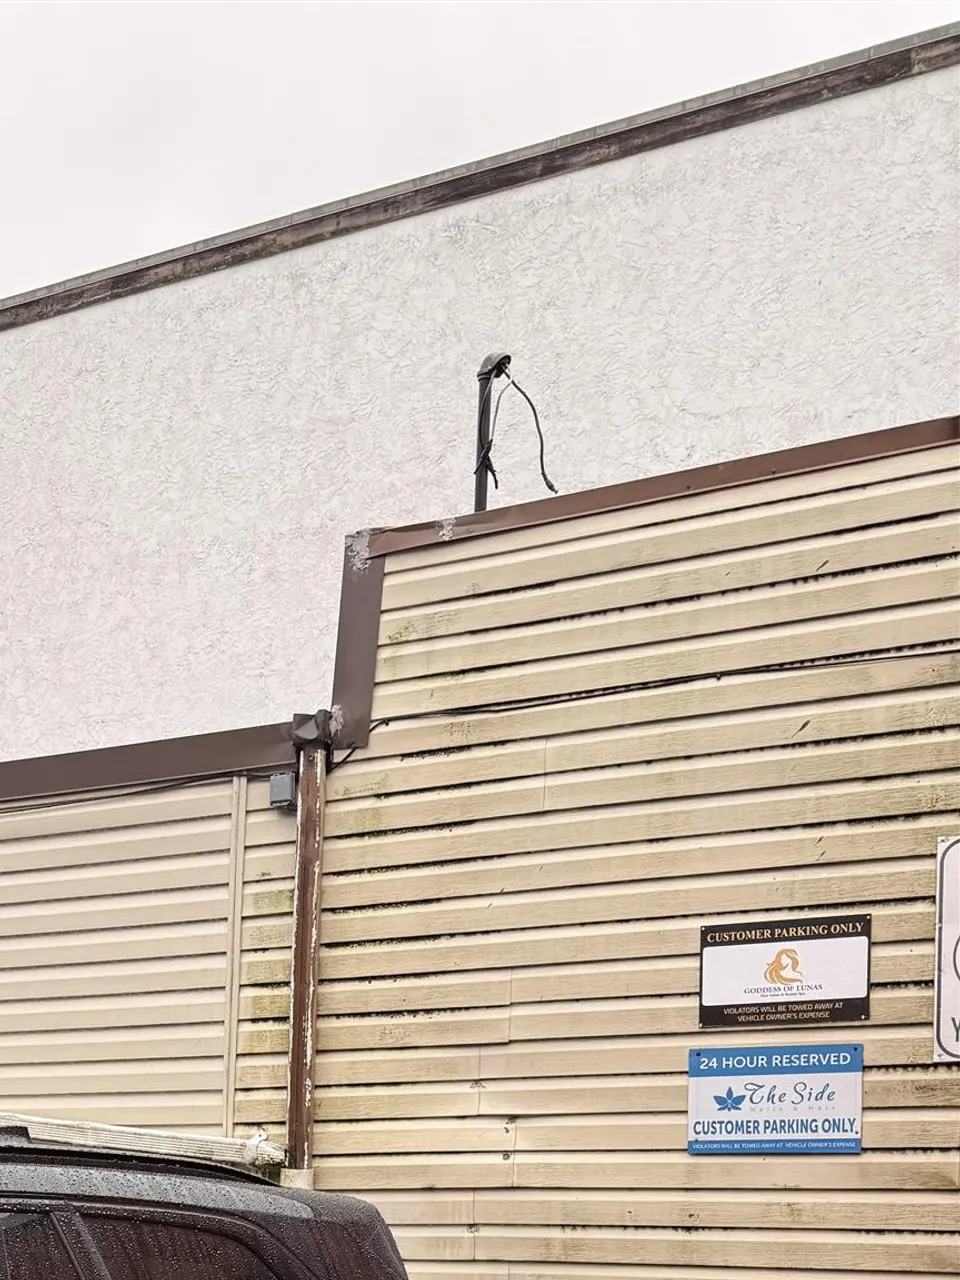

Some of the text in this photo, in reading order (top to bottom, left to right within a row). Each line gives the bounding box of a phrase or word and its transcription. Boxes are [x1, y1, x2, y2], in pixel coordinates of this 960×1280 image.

[707, 922, 864, 943] CUSTOMER PARKING ONLY
[744, 986, 782, 995] GODDESS
[724, 1006, 759, 1015] VIOLATORS
[738, 1014, 765, 1022] VEHICLE
[700, 1053, 850, 1069] 24 HOUR RESERVED
[744, 1081, 836, 1105] The Side
[693, 1118, 856, 1135] CUSTOMER PARKING ONLY
